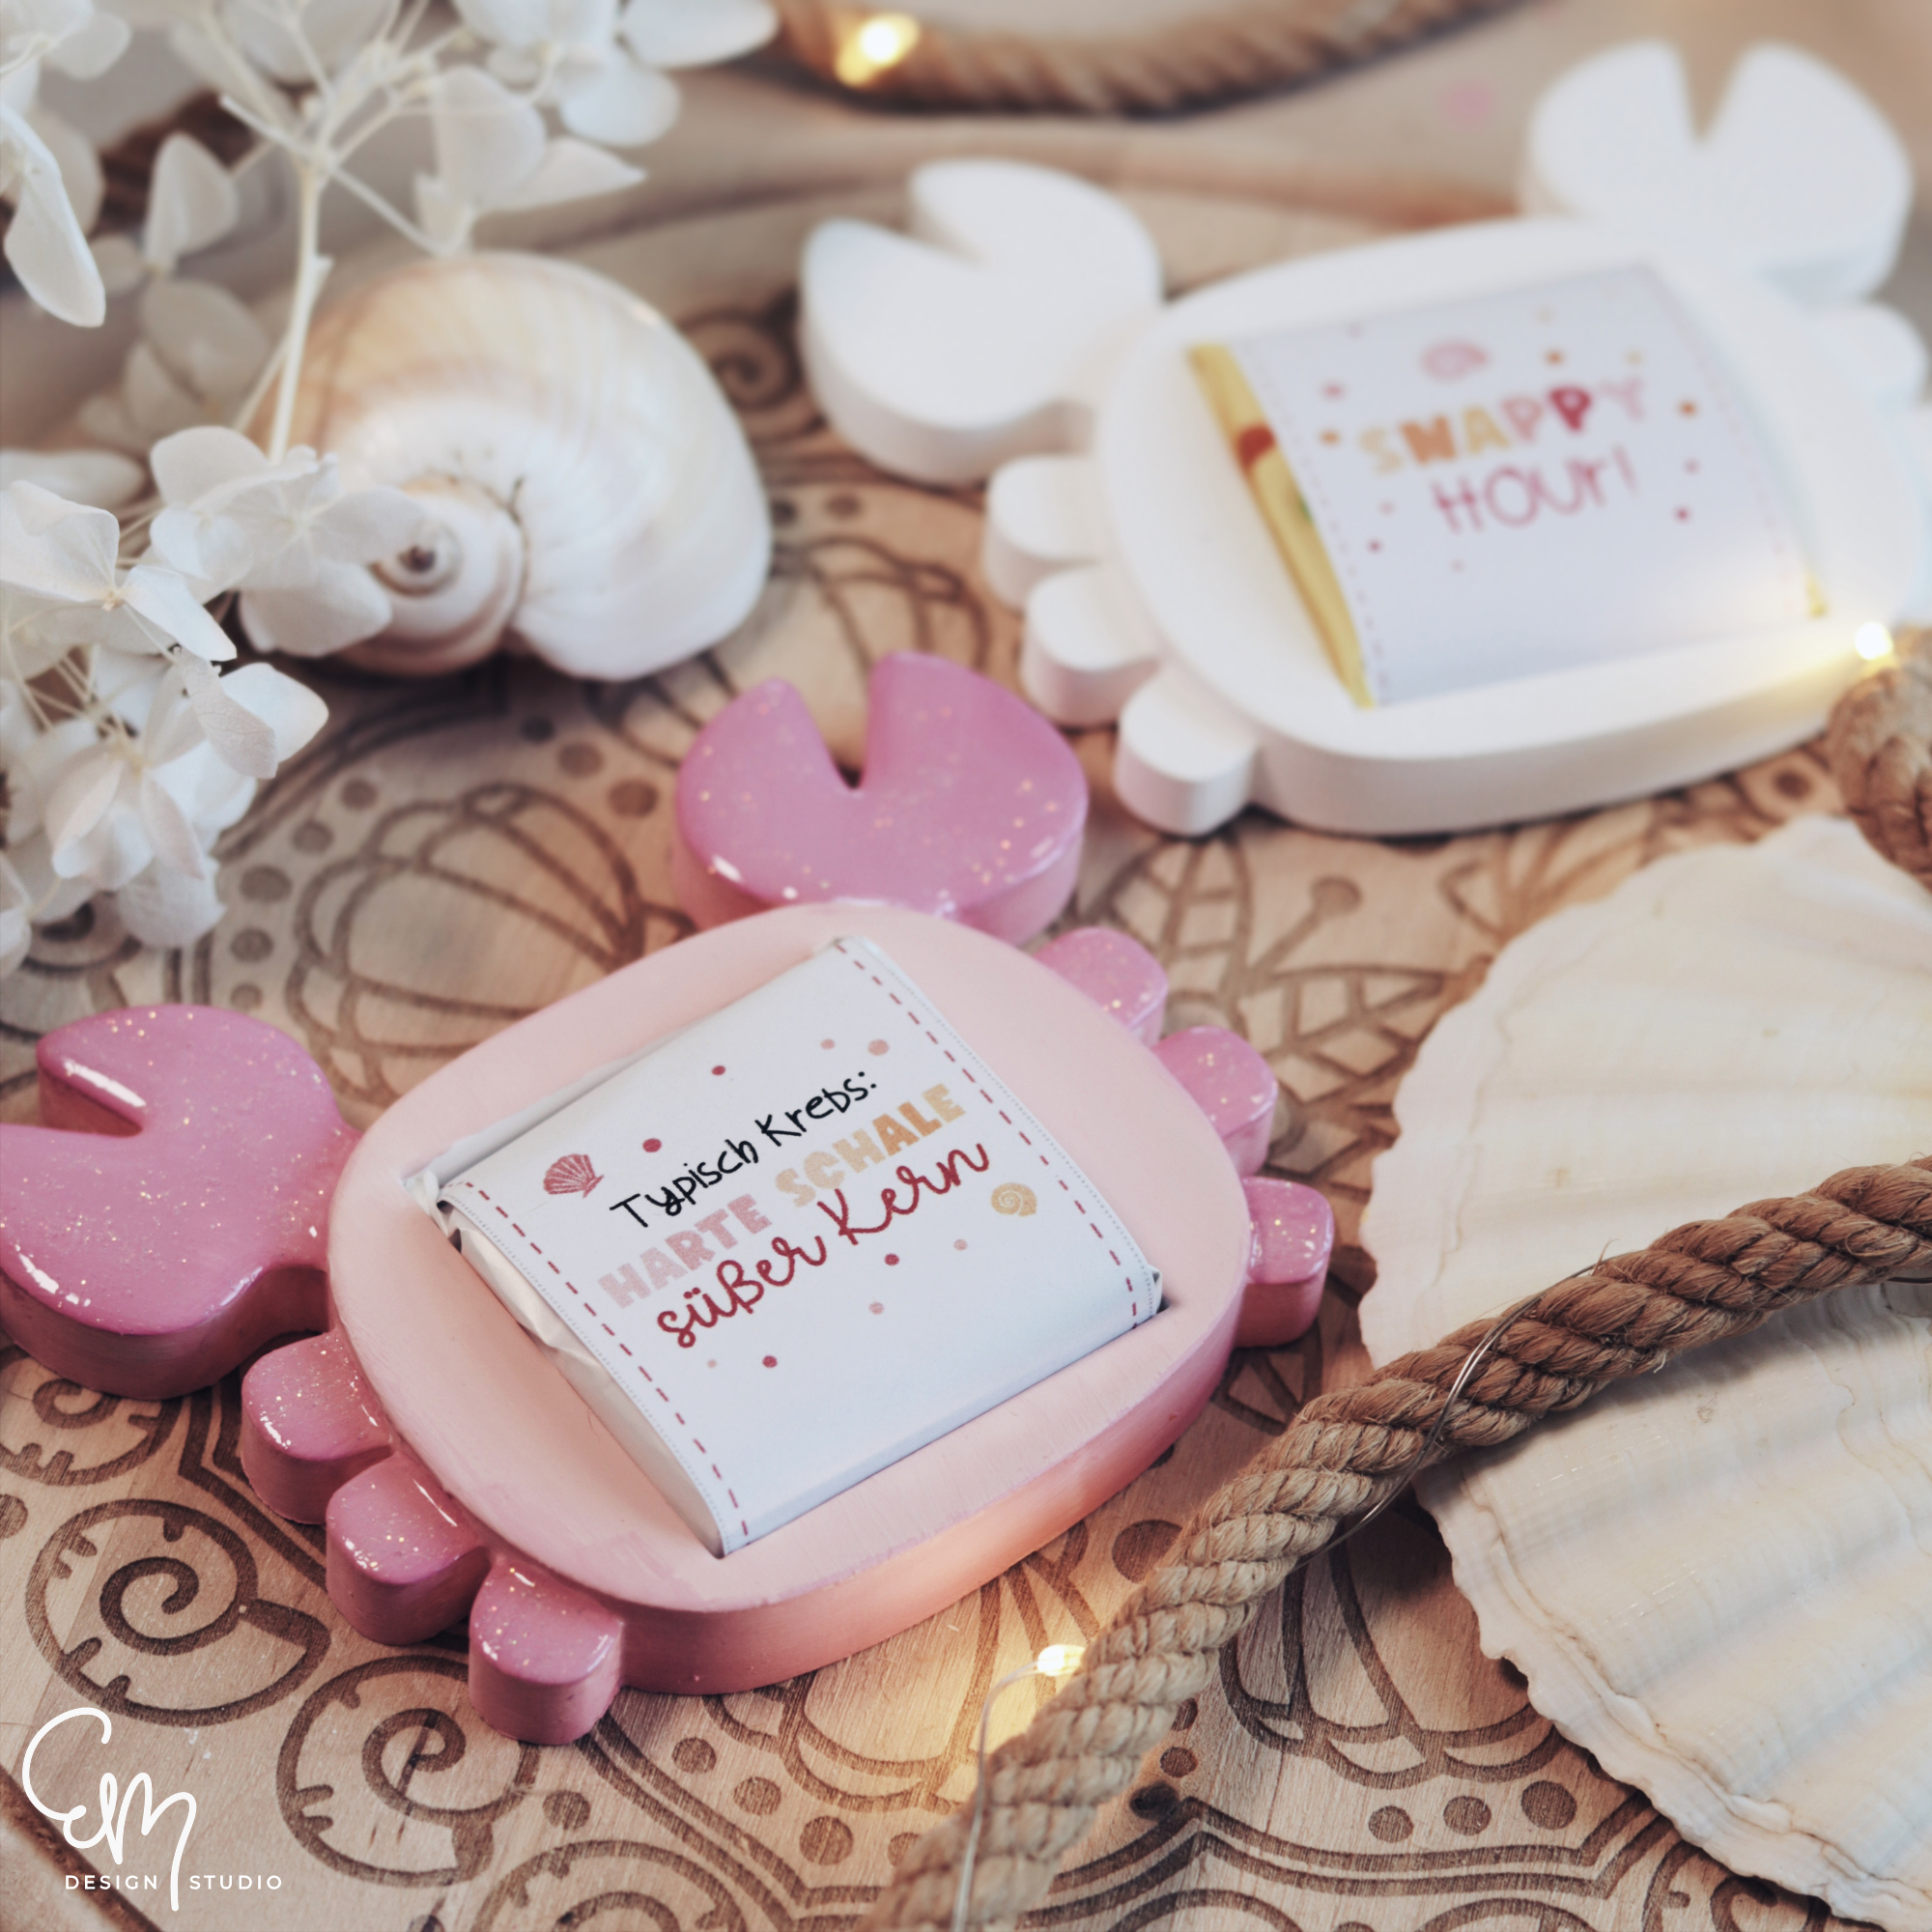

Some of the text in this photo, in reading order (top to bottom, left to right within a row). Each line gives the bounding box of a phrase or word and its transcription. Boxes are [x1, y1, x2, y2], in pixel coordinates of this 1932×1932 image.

[596, 1083, 967, 1309] HARTE SCHALE
[609, 1070, 878, 1228] Typisch Krebs:
[656, 1142, 990, 1349] süßer Kern
